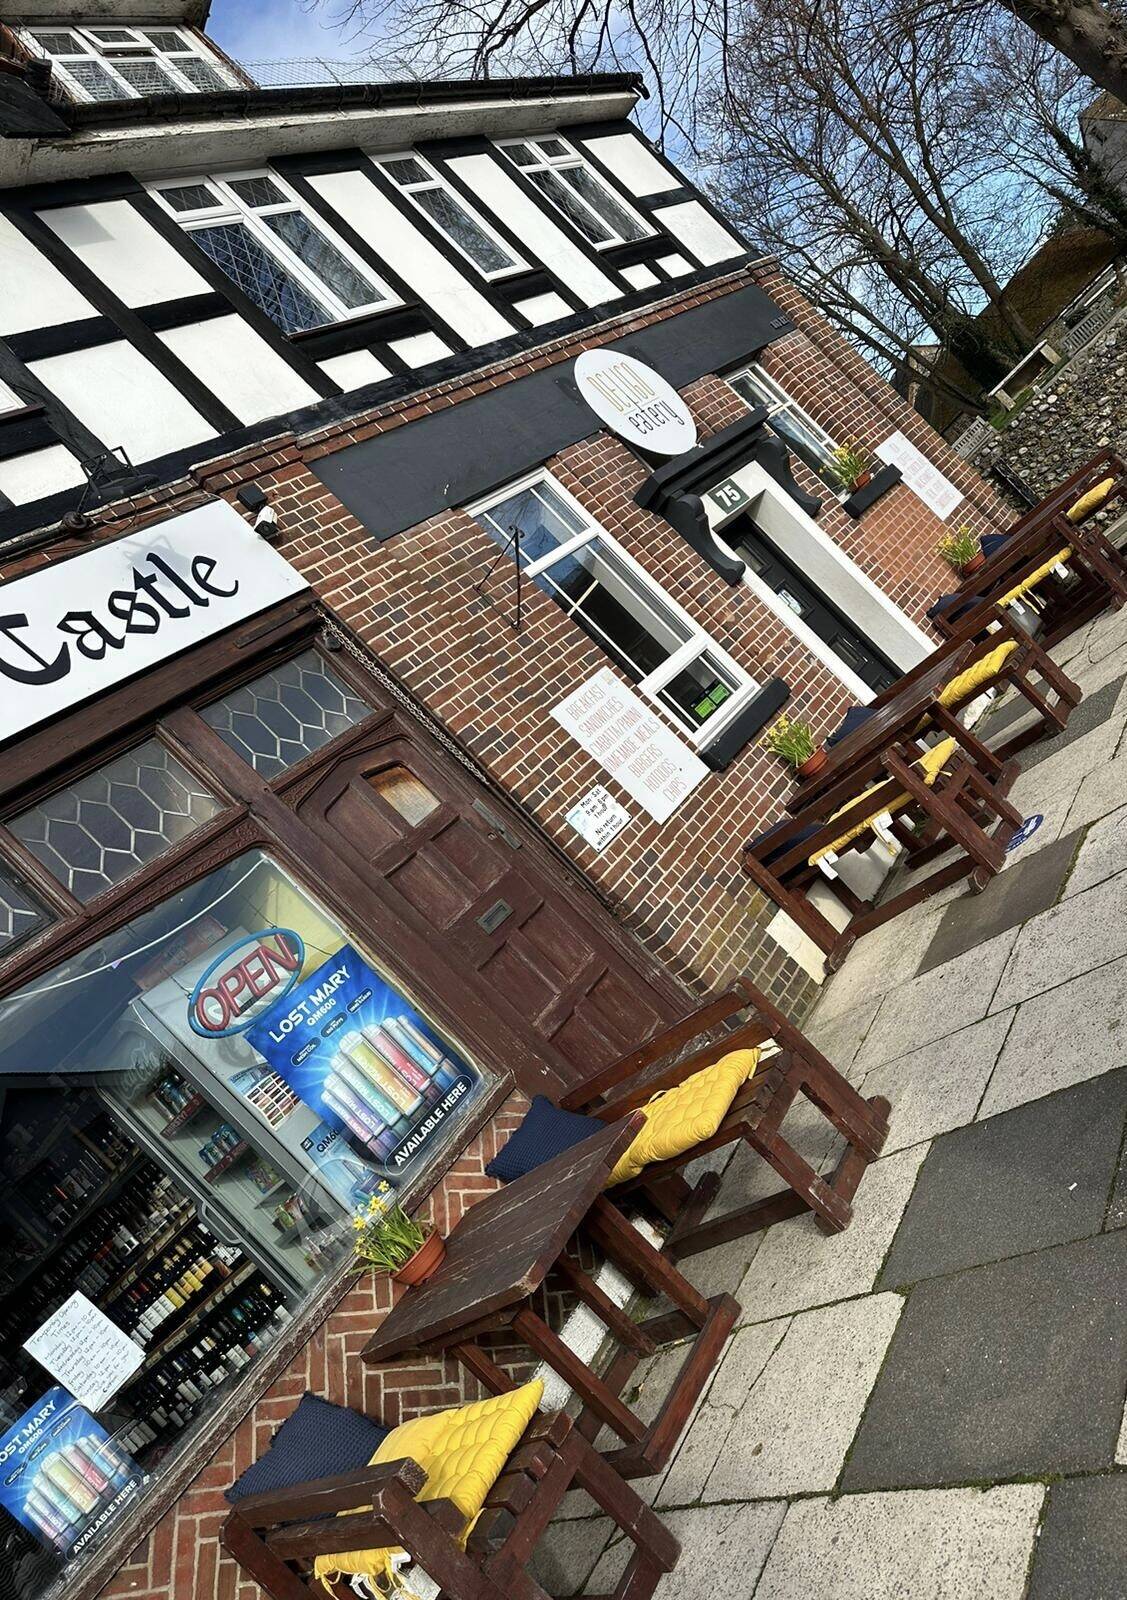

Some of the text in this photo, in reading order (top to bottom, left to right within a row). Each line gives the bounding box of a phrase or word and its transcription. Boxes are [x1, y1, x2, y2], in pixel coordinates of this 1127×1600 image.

[628, 394, 685, 435] eatery
[715, 485, 741, 507] 75
[0, 552, 239, 685] Castle
[565, 683, 606, 720] BREAKFAST
[577, 695, 624, 738] SANDWICHES
[632, 716, 661, 743] MEALS
[627, 742, 663, 778] BURGERS
[662, 776, 688, 803] CHIPS
[595, 814, 616, 835] No return
[196, 934, 299, 1031] OPEN
[268, 1000, 311, 1044] LOST
[308, 965, 352, 1007] MARY
[307, 998, 337, 1026] QM600
[395, 1109, 445, 1166] AVAILABLE
[440, 1082, 467, 1115] HERE
[51, 1321, 70, 1338] Times
[0, 1435, 22, 1466] OST
[22, 1400, 56, 1436] MARY
[73, 1480, 137, 1553] AVAILABLE HERE
